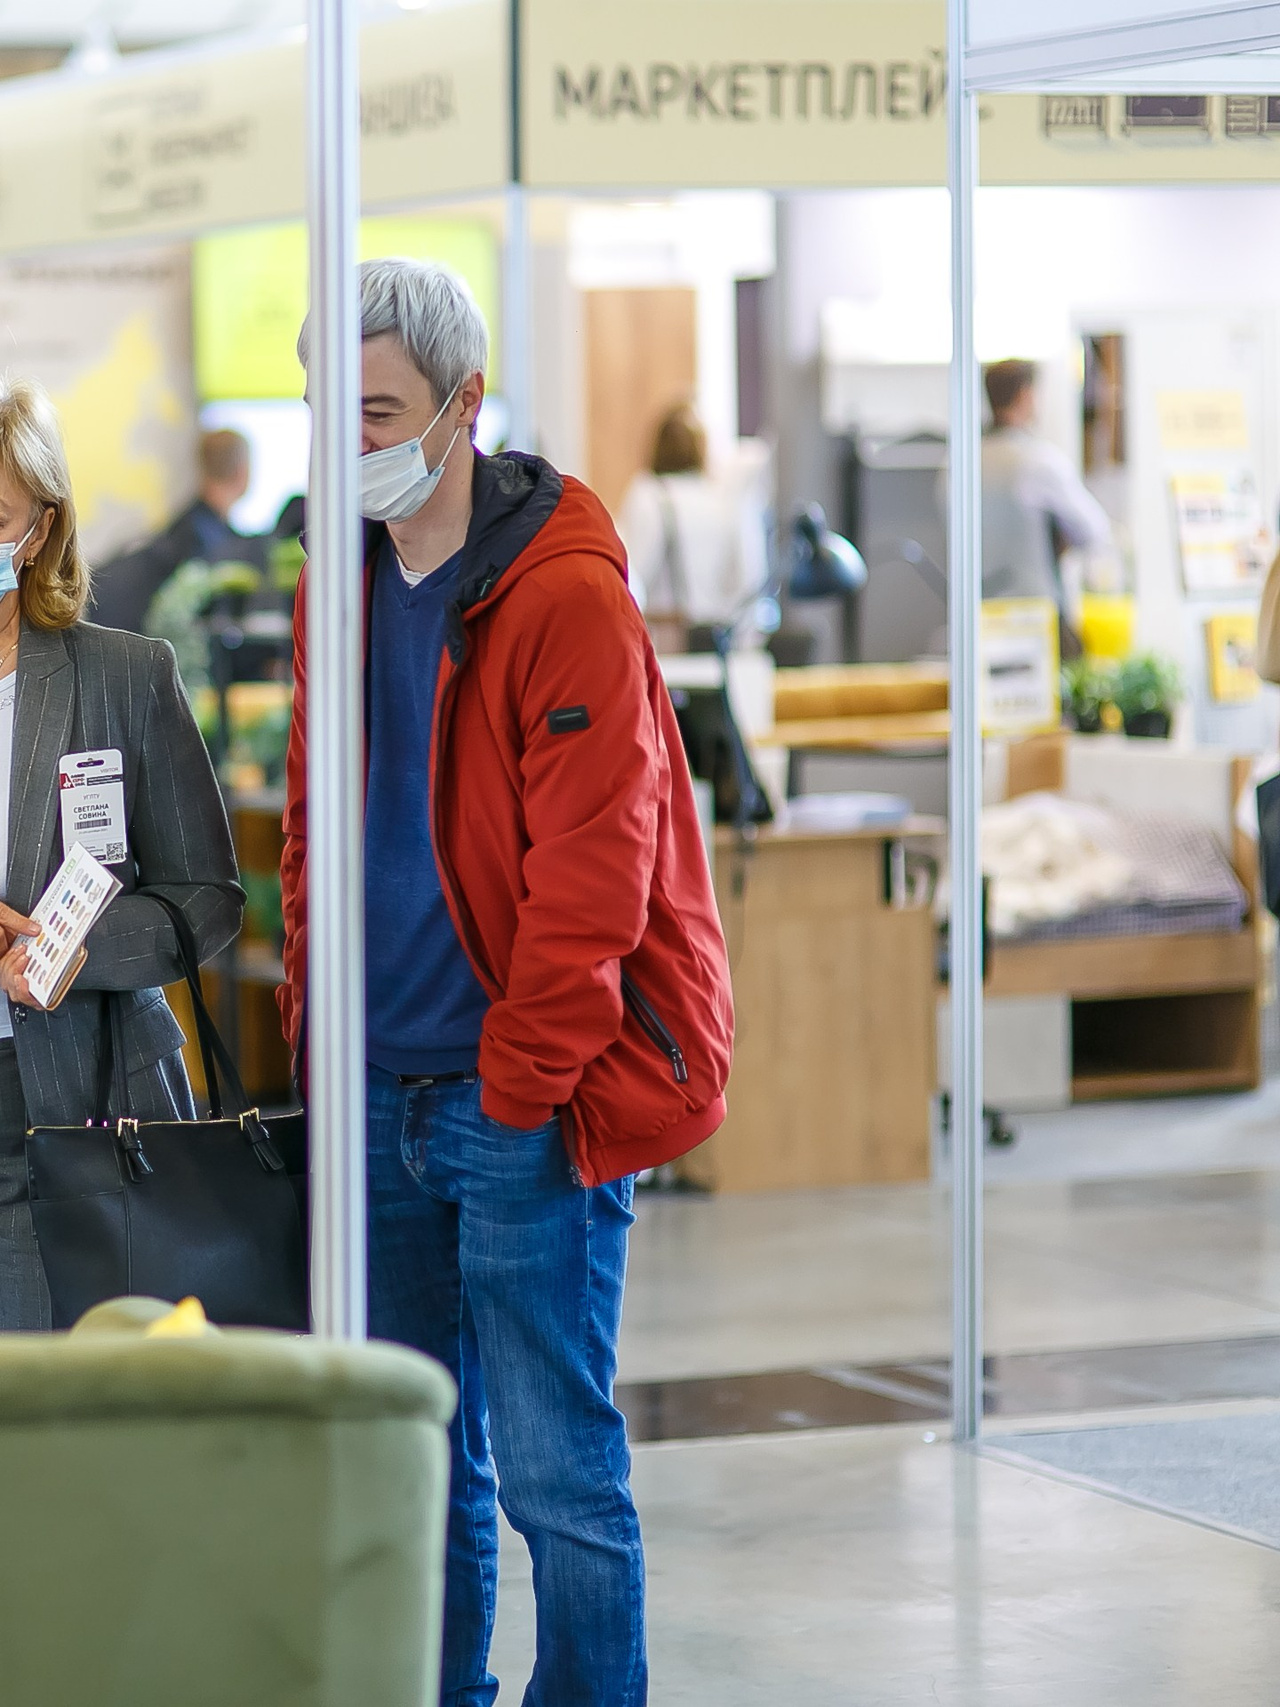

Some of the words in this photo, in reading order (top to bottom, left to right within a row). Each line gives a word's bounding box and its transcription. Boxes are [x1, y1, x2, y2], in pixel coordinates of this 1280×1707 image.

[553, 47, 993, 122] МАРКЕТПЛЕЙ
[73, 803, 109, 813] СВЕТЛАНА
[78, 811, 107, 820] СОВИНА
